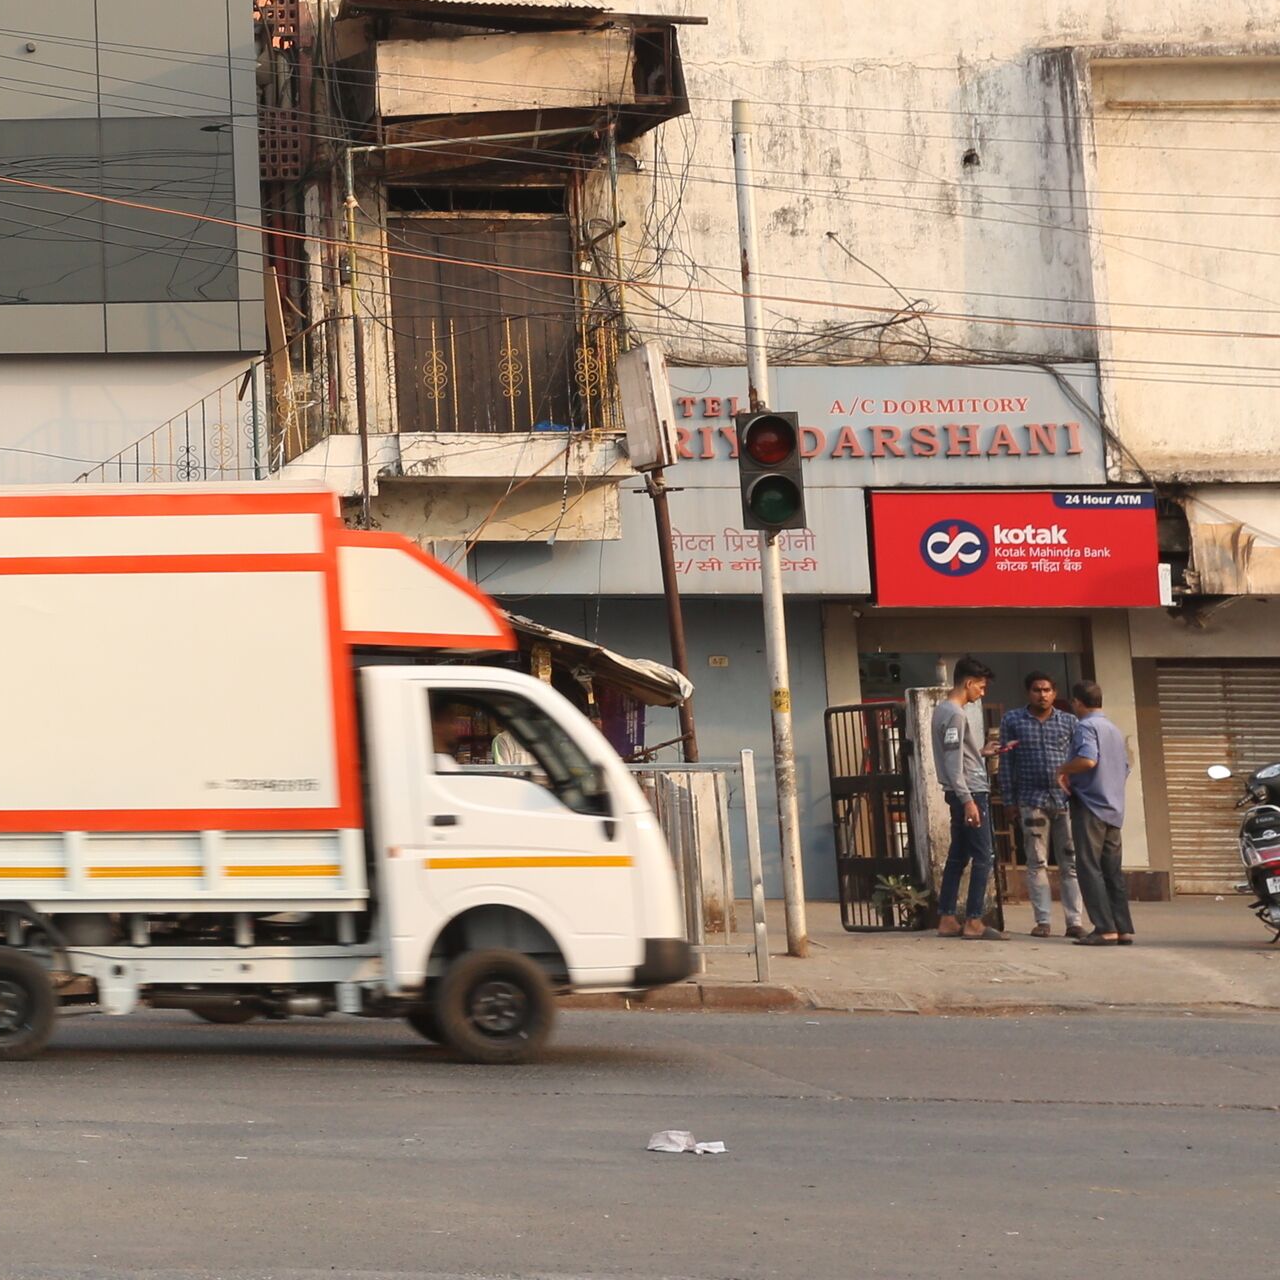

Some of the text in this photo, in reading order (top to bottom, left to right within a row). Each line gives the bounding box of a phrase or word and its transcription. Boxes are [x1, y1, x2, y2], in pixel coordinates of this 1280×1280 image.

[678, 396, 746, 418] TEL
[830, 396, 1029, 416] A/C DORMITORY
[676, 422, 1084, 460] RIYDARSHANI
[1065, 495, 1142, 505] 24 Hour ATM
[993, 524, 1068, 545] kotak
[995, 547, 1111, 558] Kotak Mahindra Bank
[996, 559, 1028, 572] कोटक
